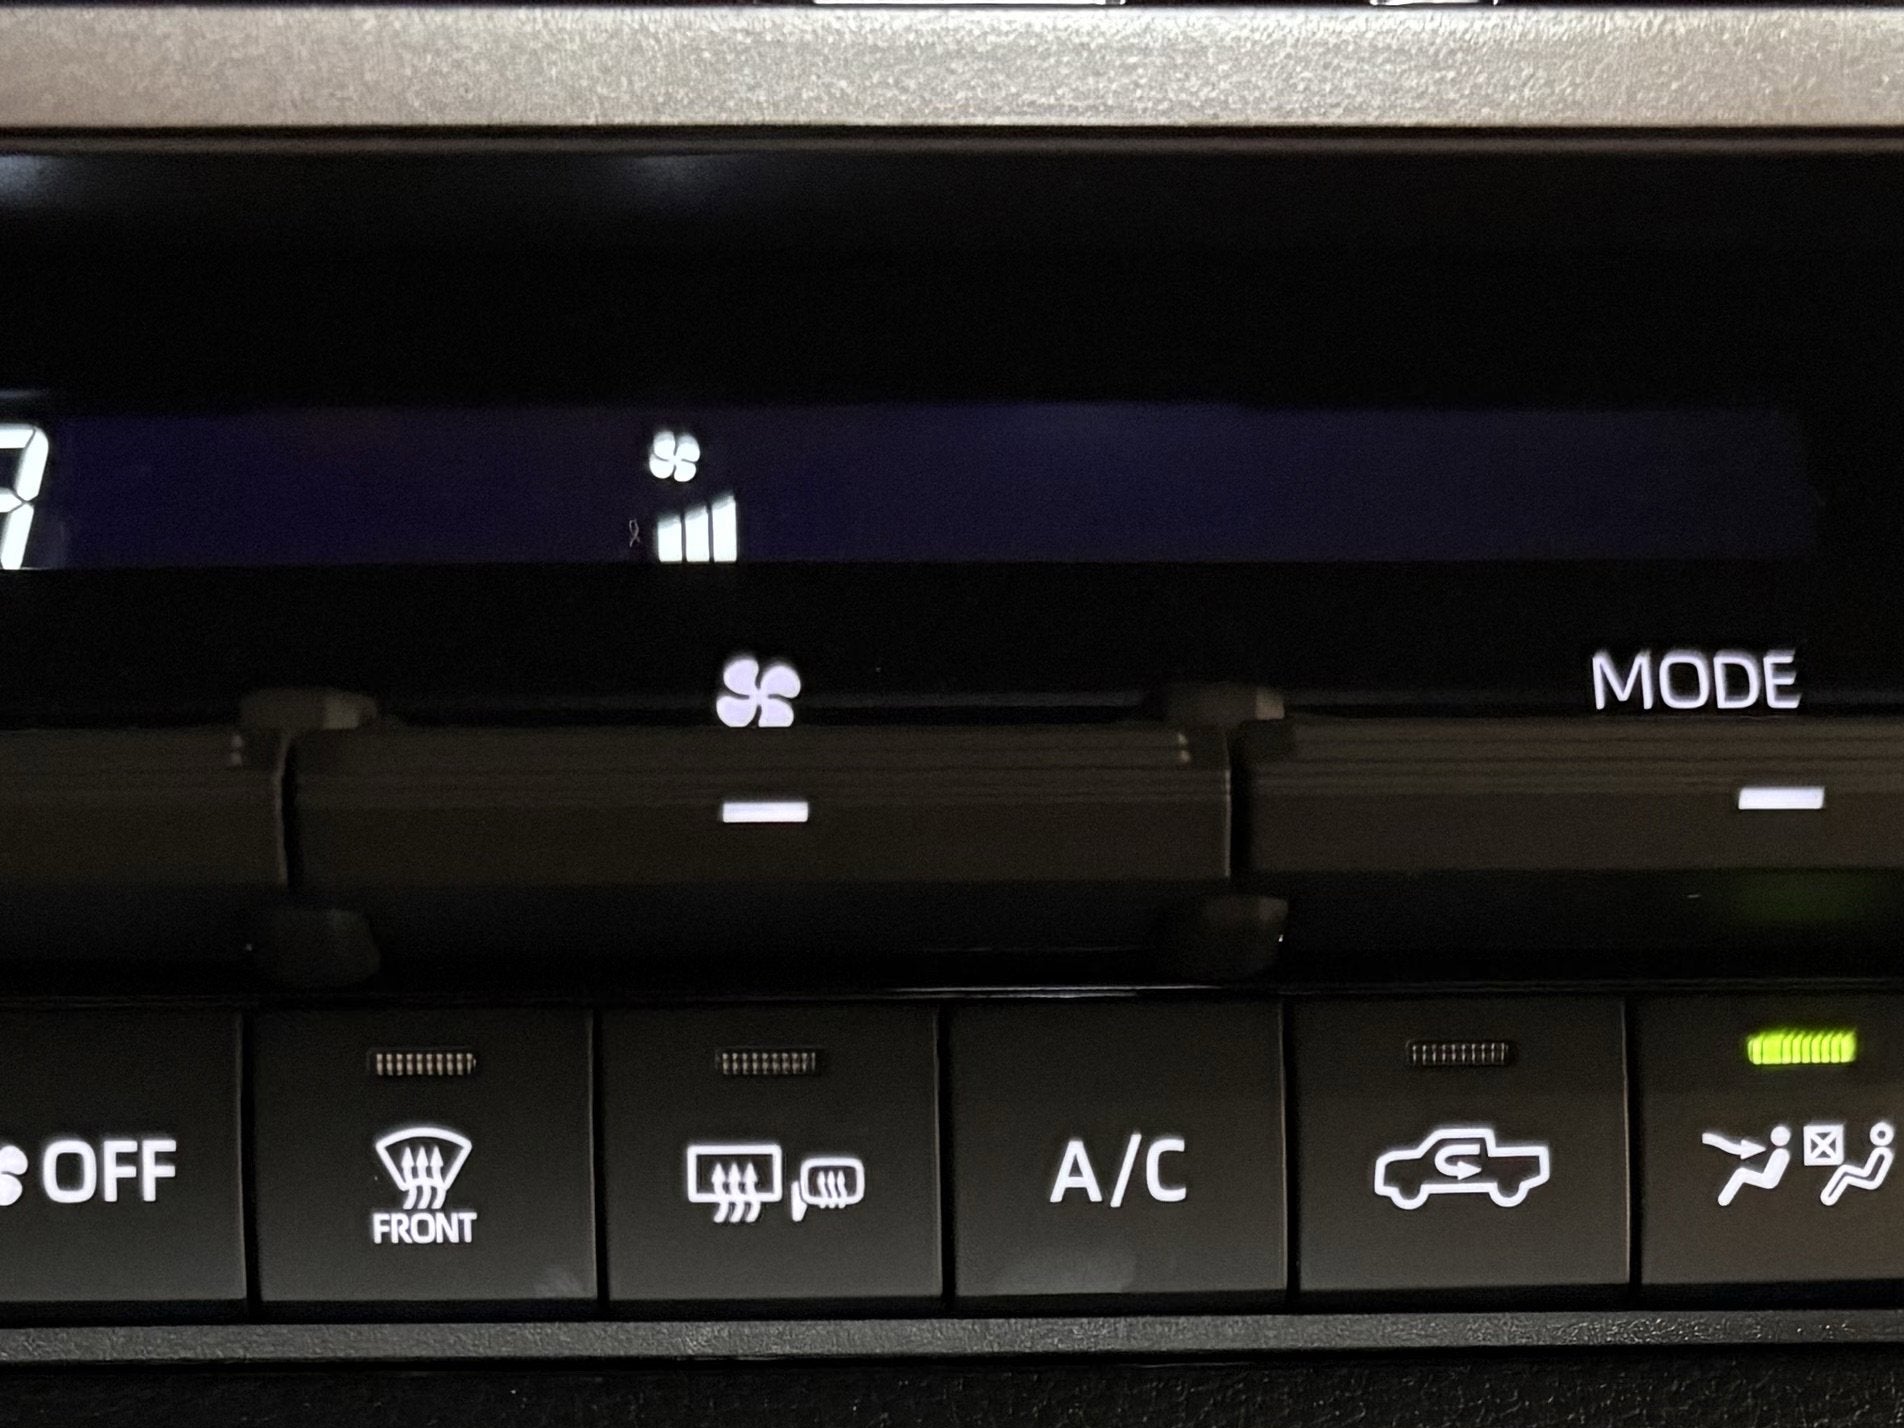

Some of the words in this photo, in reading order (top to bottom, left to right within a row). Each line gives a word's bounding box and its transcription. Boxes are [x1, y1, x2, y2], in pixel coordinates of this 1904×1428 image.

[1593, 652, 1799, 708] MODE
[42, 1139, 176, 1203] OFF
[1050, 1133, 1186, 1207] A/C
[372, 1211, 477, 1243] FRONT
